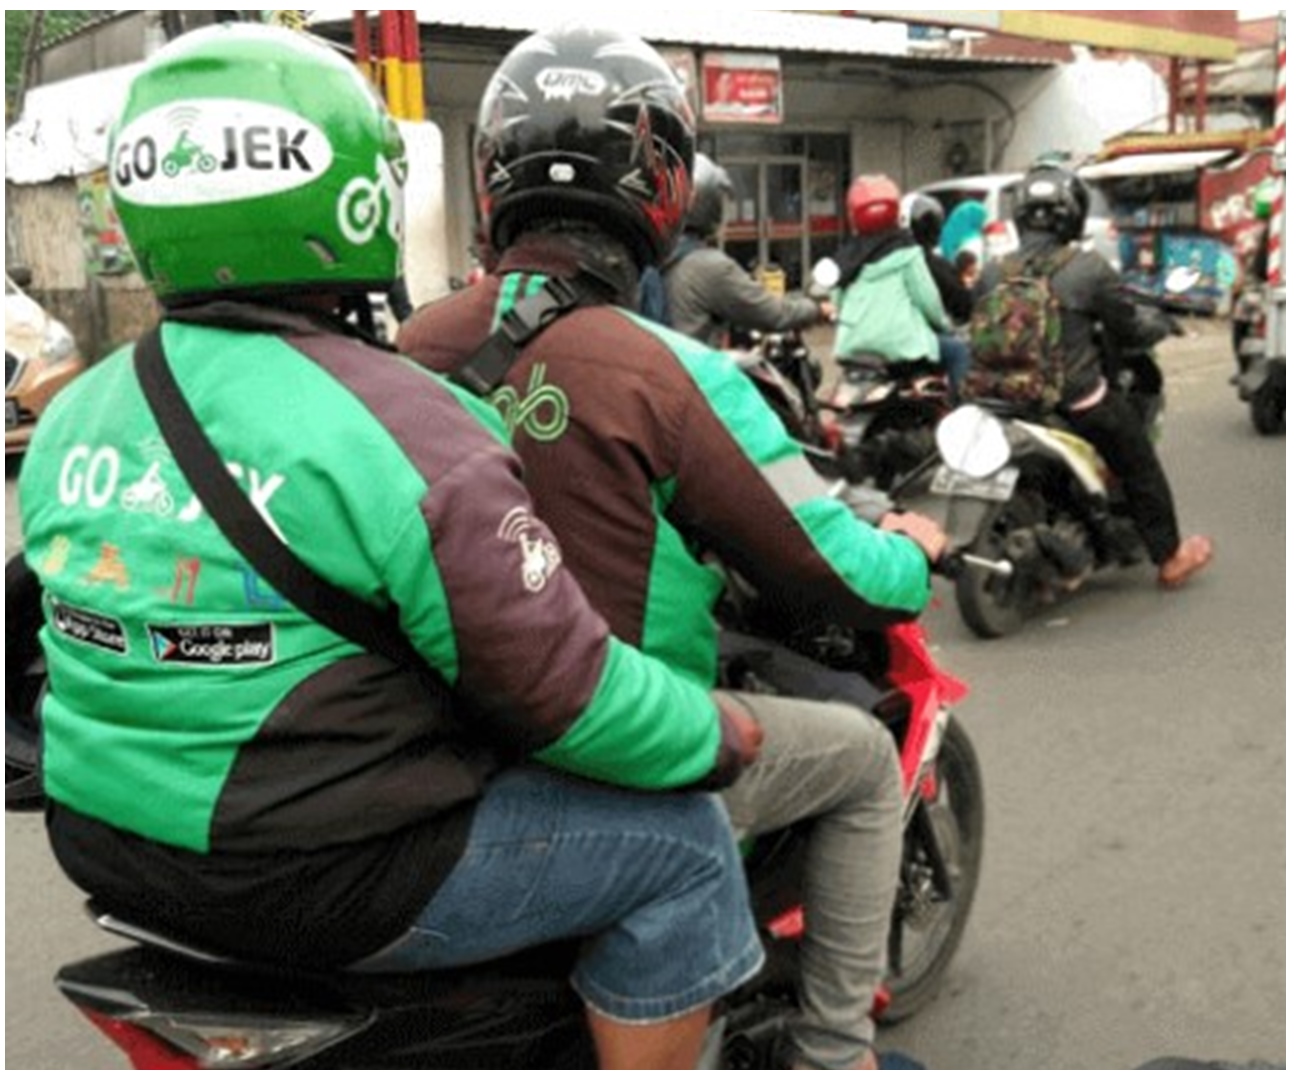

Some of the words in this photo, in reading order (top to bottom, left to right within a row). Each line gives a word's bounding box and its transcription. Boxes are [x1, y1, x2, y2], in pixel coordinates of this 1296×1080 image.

[115, 135, 157, 187] GO
[220, 126, 313, 172] JEK
[58, 444, 120, 508] GO
[179, 638, 234, 662] Google
